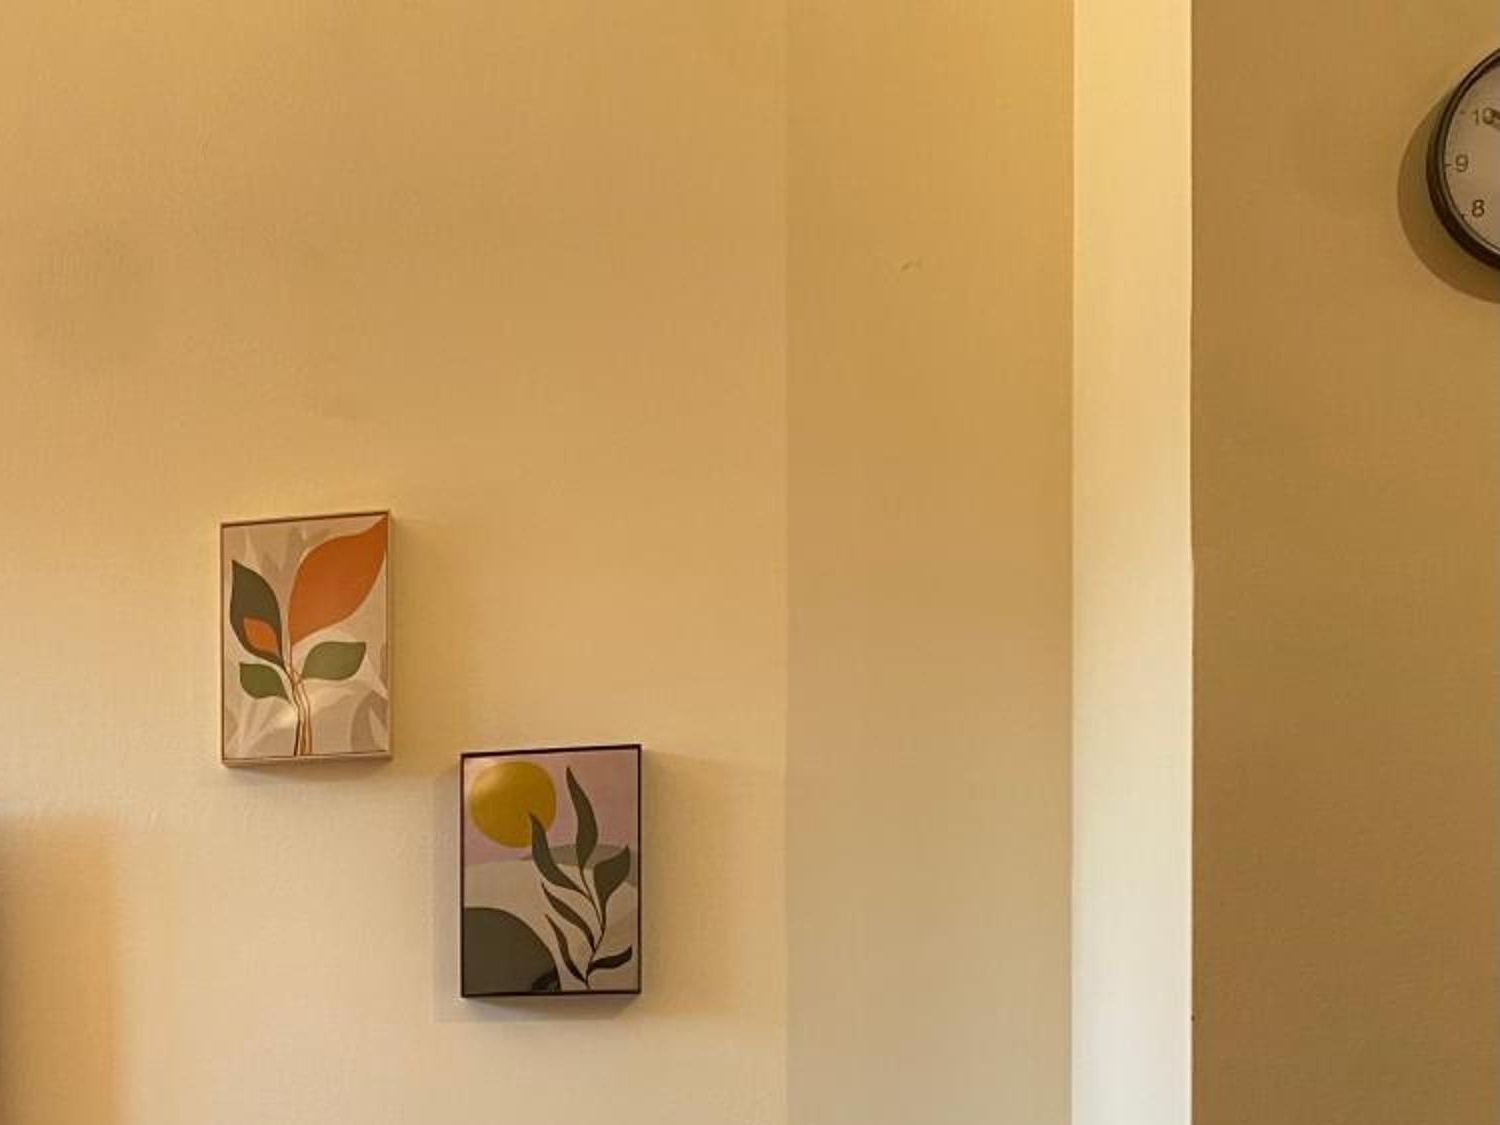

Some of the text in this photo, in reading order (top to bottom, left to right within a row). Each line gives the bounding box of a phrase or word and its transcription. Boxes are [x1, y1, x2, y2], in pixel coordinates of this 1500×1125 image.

[1473, 107, 1495, 126] 10
[1454, 153, 1469, 173] 9
[1471, 199, 1485, 218] 8
